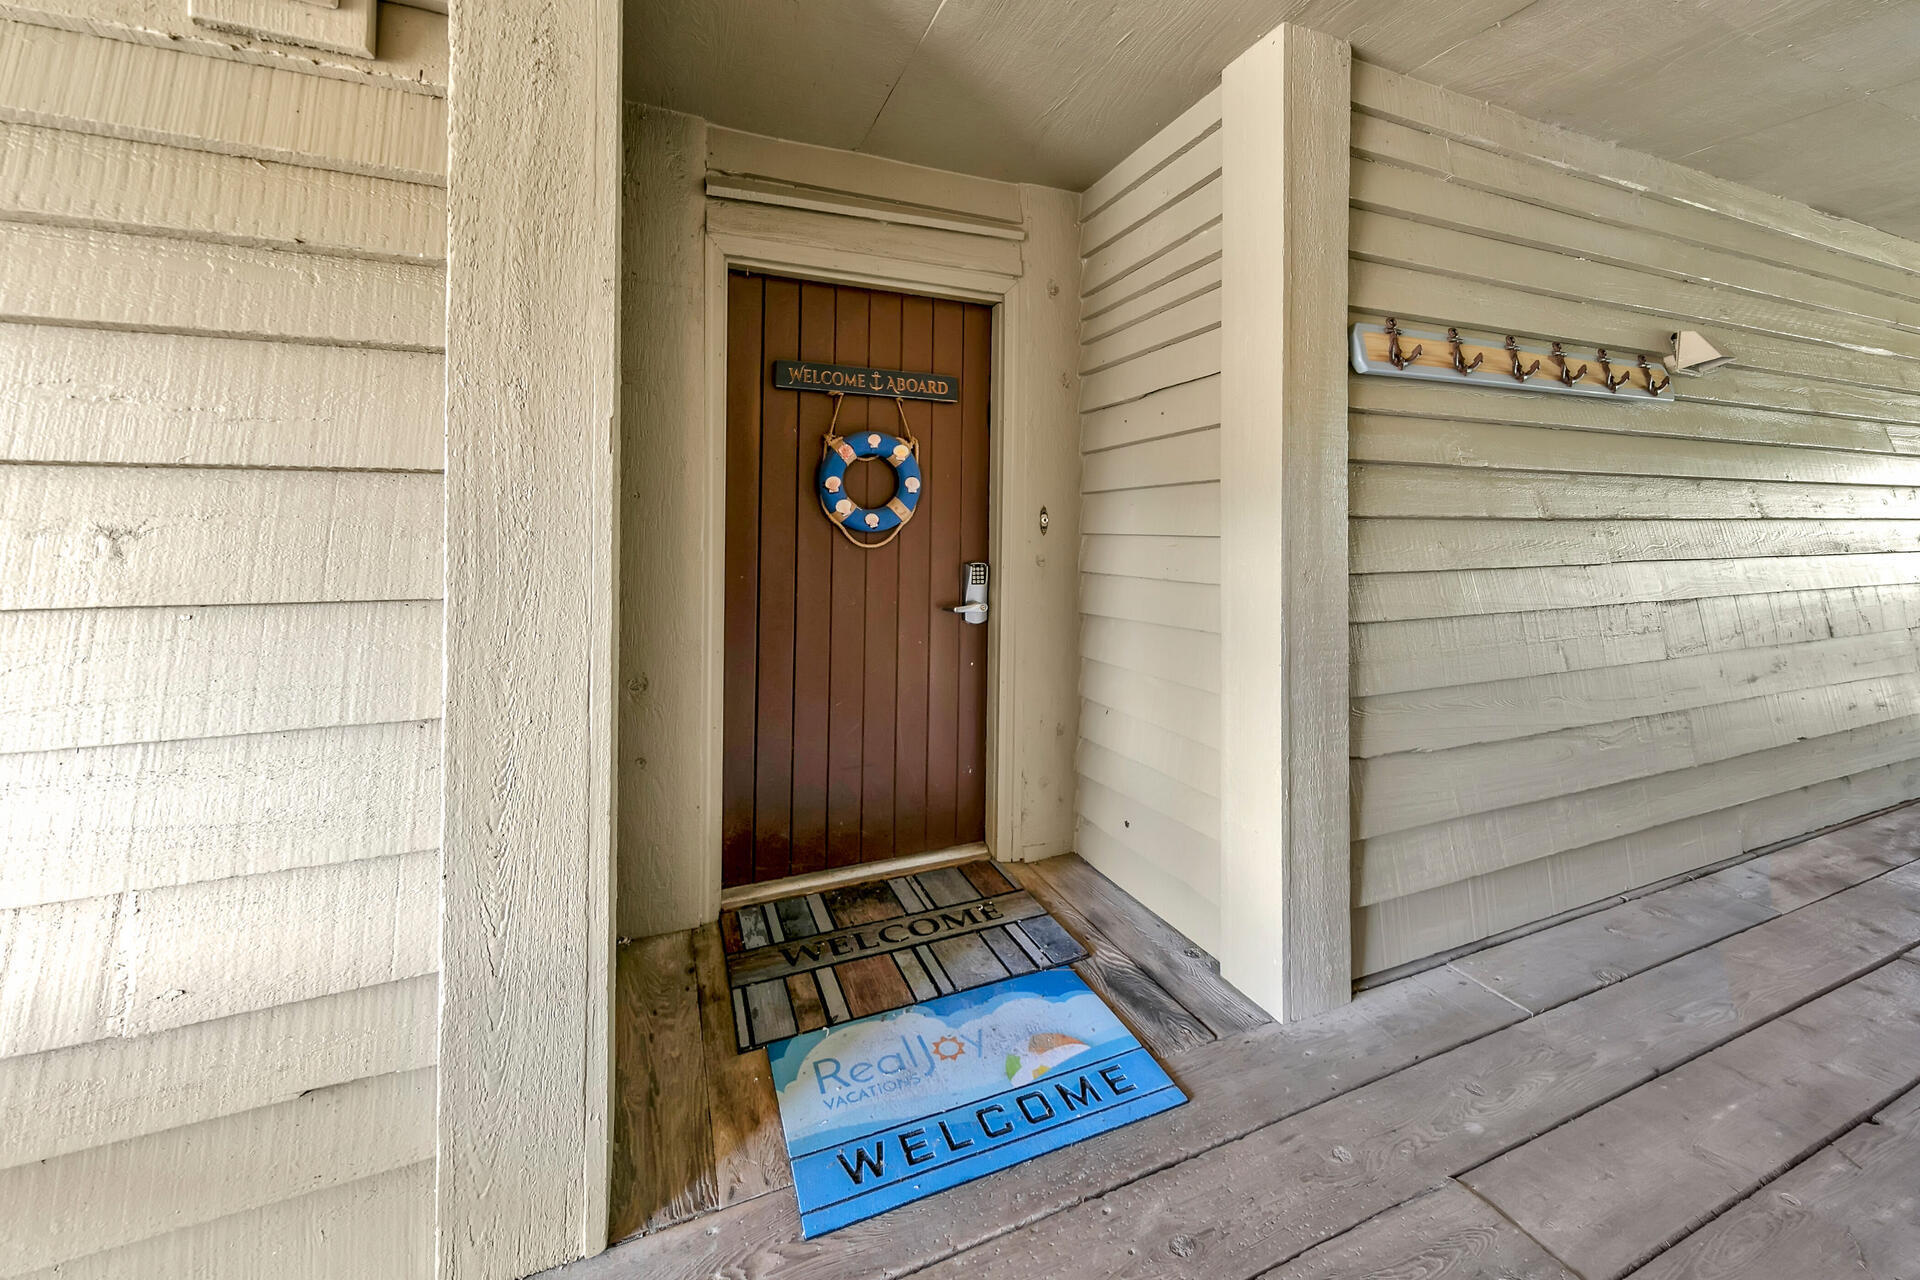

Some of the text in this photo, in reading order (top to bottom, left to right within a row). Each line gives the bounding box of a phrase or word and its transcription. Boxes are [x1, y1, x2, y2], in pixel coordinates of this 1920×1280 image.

[788, 365, 949, 395] WELCOME ABOARD
[779, 901, 1004, 967] WELCOME
[823, 1072, 921, 1110] VACATIONS
[836, 1063, 1137, 1186] WELCOME
